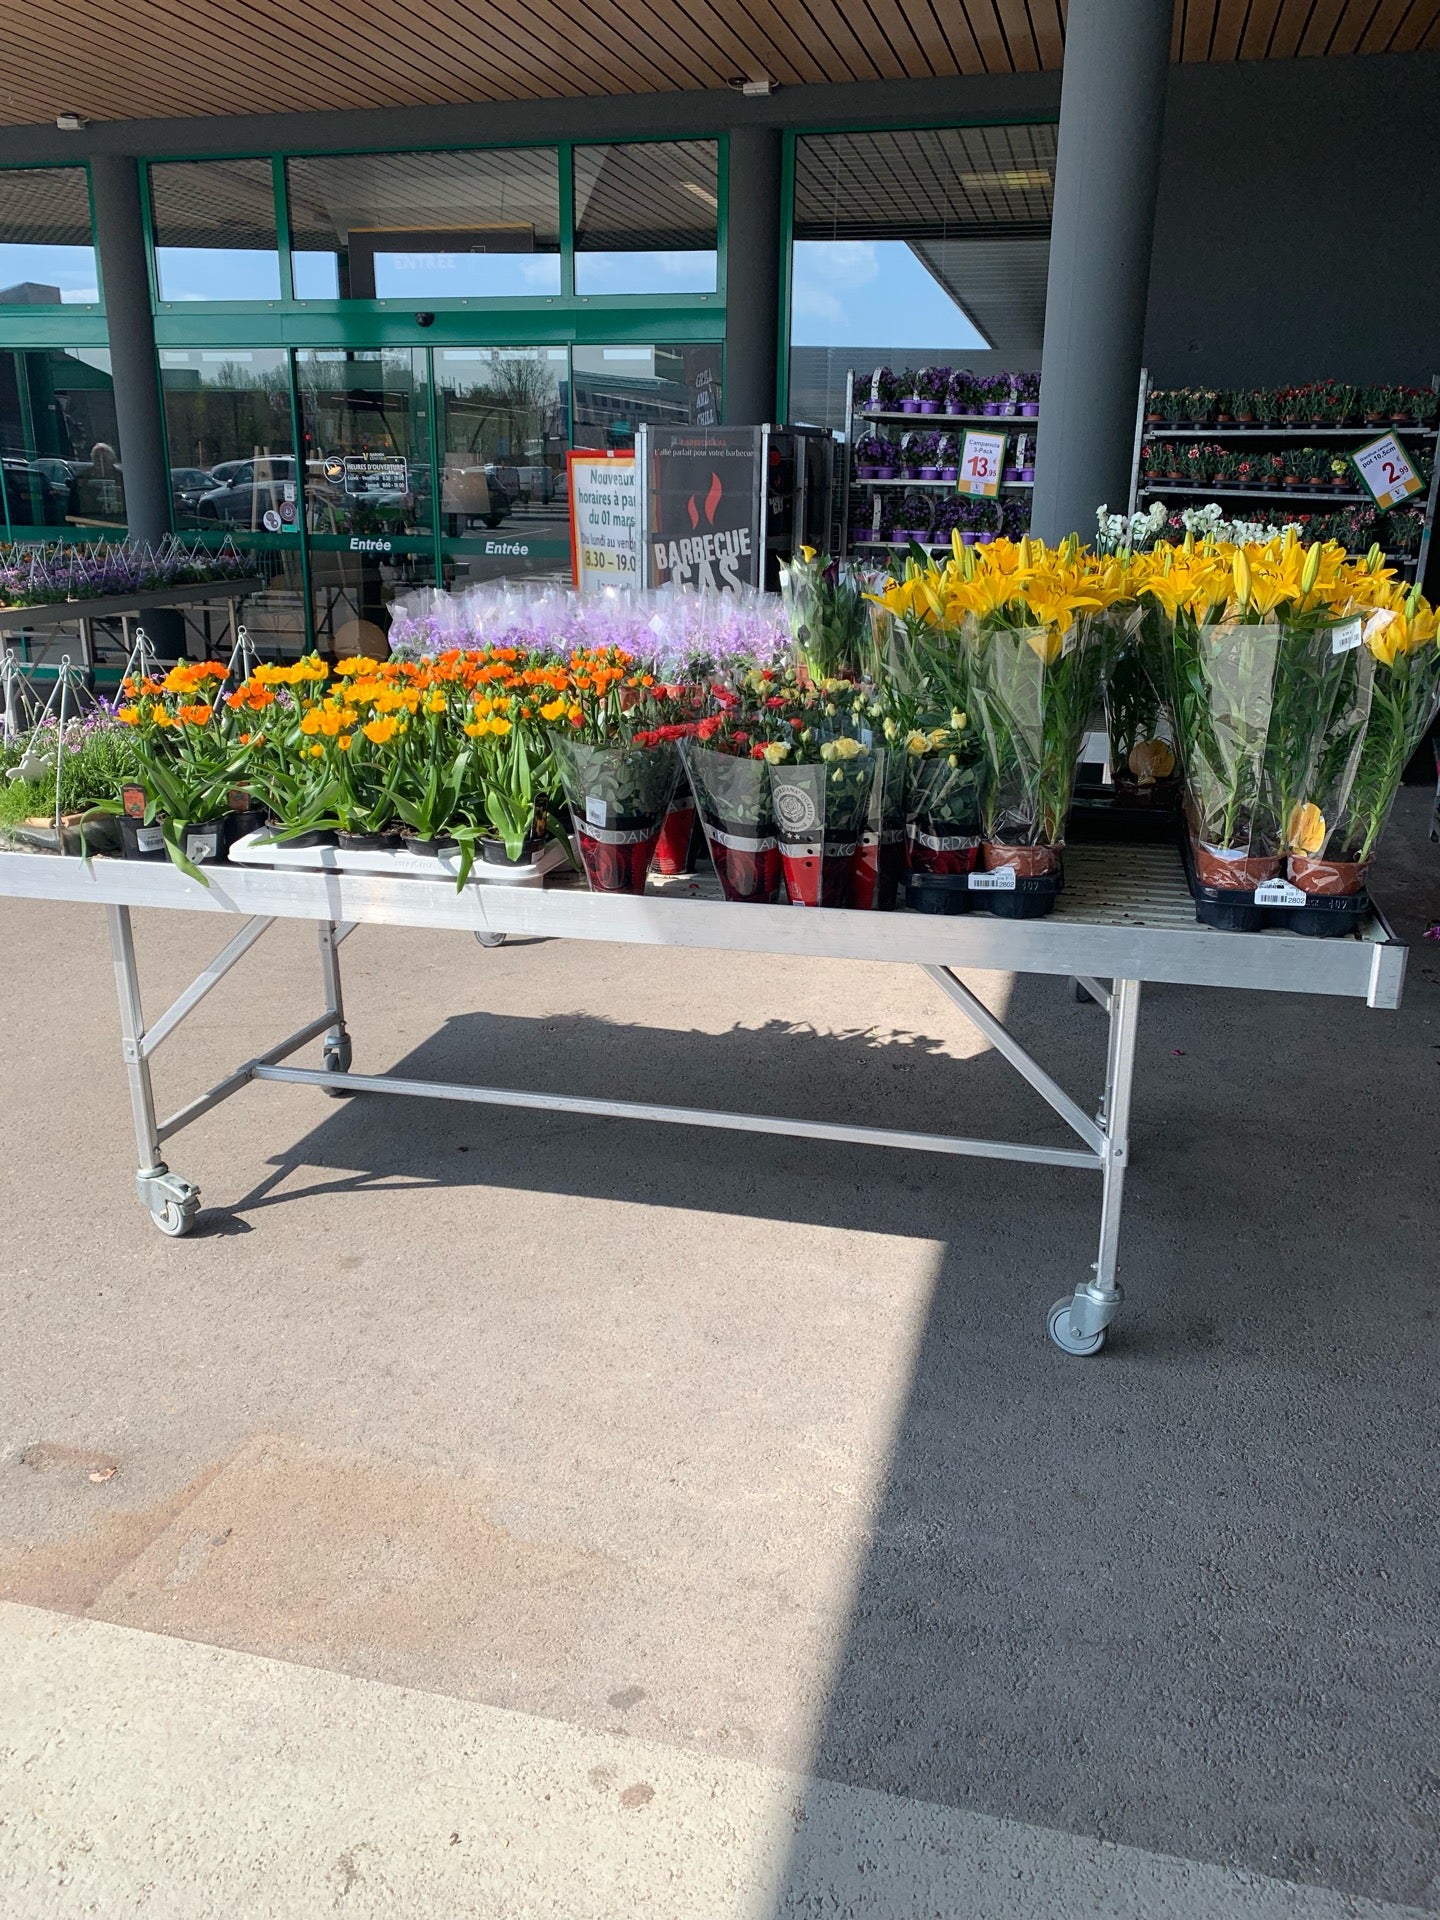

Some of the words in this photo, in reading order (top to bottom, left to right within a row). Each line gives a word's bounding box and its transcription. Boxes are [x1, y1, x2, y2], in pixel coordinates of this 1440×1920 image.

[696, 390, 710, 408] AND
[672, 448, 692, 457] parfait
[708, 449, 724, 457] votre
[725, 448, 754, 457] barbecue
[1362, 459, 1374, 468] pot
[590, 469, 635, 486] Nouveaux
[578, 488, 612, 506] horaires
[613, 491, 619, 506] à
[589, 508, 599, 525] du
[601, 510, 610, 526] 01
[613, 515, 635, 527] mars
[350, 537, 392, 551] Entrée
[485, 541, 529, 556] Entrée
[581, 532, 590, 545] Du
[590, 533, 606, 547] lundi
[607, 538, 615, 548] au
[654, 527, 751, 570] BARBECUE
[585, 550, 605, 568] 8.30
[672, 557, 743, 602] GAS
